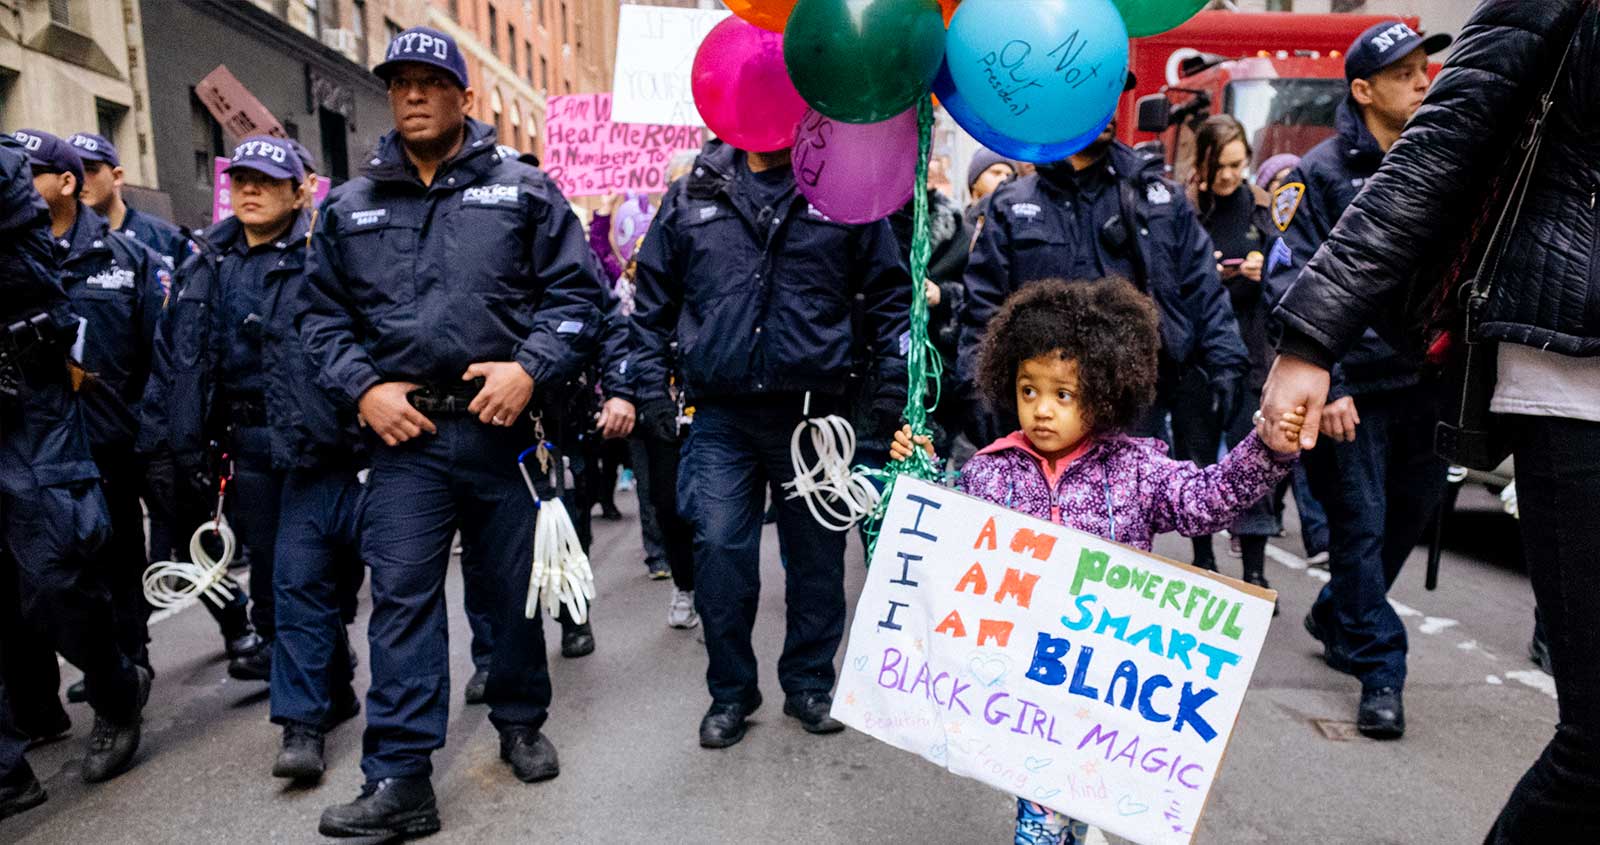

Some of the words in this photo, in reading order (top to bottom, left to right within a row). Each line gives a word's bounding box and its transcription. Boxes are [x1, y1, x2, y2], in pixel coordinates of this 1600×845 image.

[387, 32, 447, 60] NYPD
[999, 39, 1044, 96] Our
[1047, 29, 1102, 89] Not
[976, 51, 1029, 116] President
[14, 131, 42, 151] PD
[232, 141, 286, 163] NYPD
[548, 123, 604, 145] Hear
[609, 122, 640, 145] Me
[900, 493, 942, 543] I
[973, 515, 1059, 561] AM
[1069, 547, 1244, 640] POWERFUL
[889, 551, 923, 588] I
[954, 560, 1041, 609] AM
[1060, 594, 1243, 680] SMART
[878, 600, 910, 632] I
[934, 609, 1015, 647] AM
[1025, 631, 1219, 743] BLACK
[878, 647, 972, 716] BLACK
[983, 692, 1062, 746] GIRL
[1076, 723, 1205, 790] MAGIC
